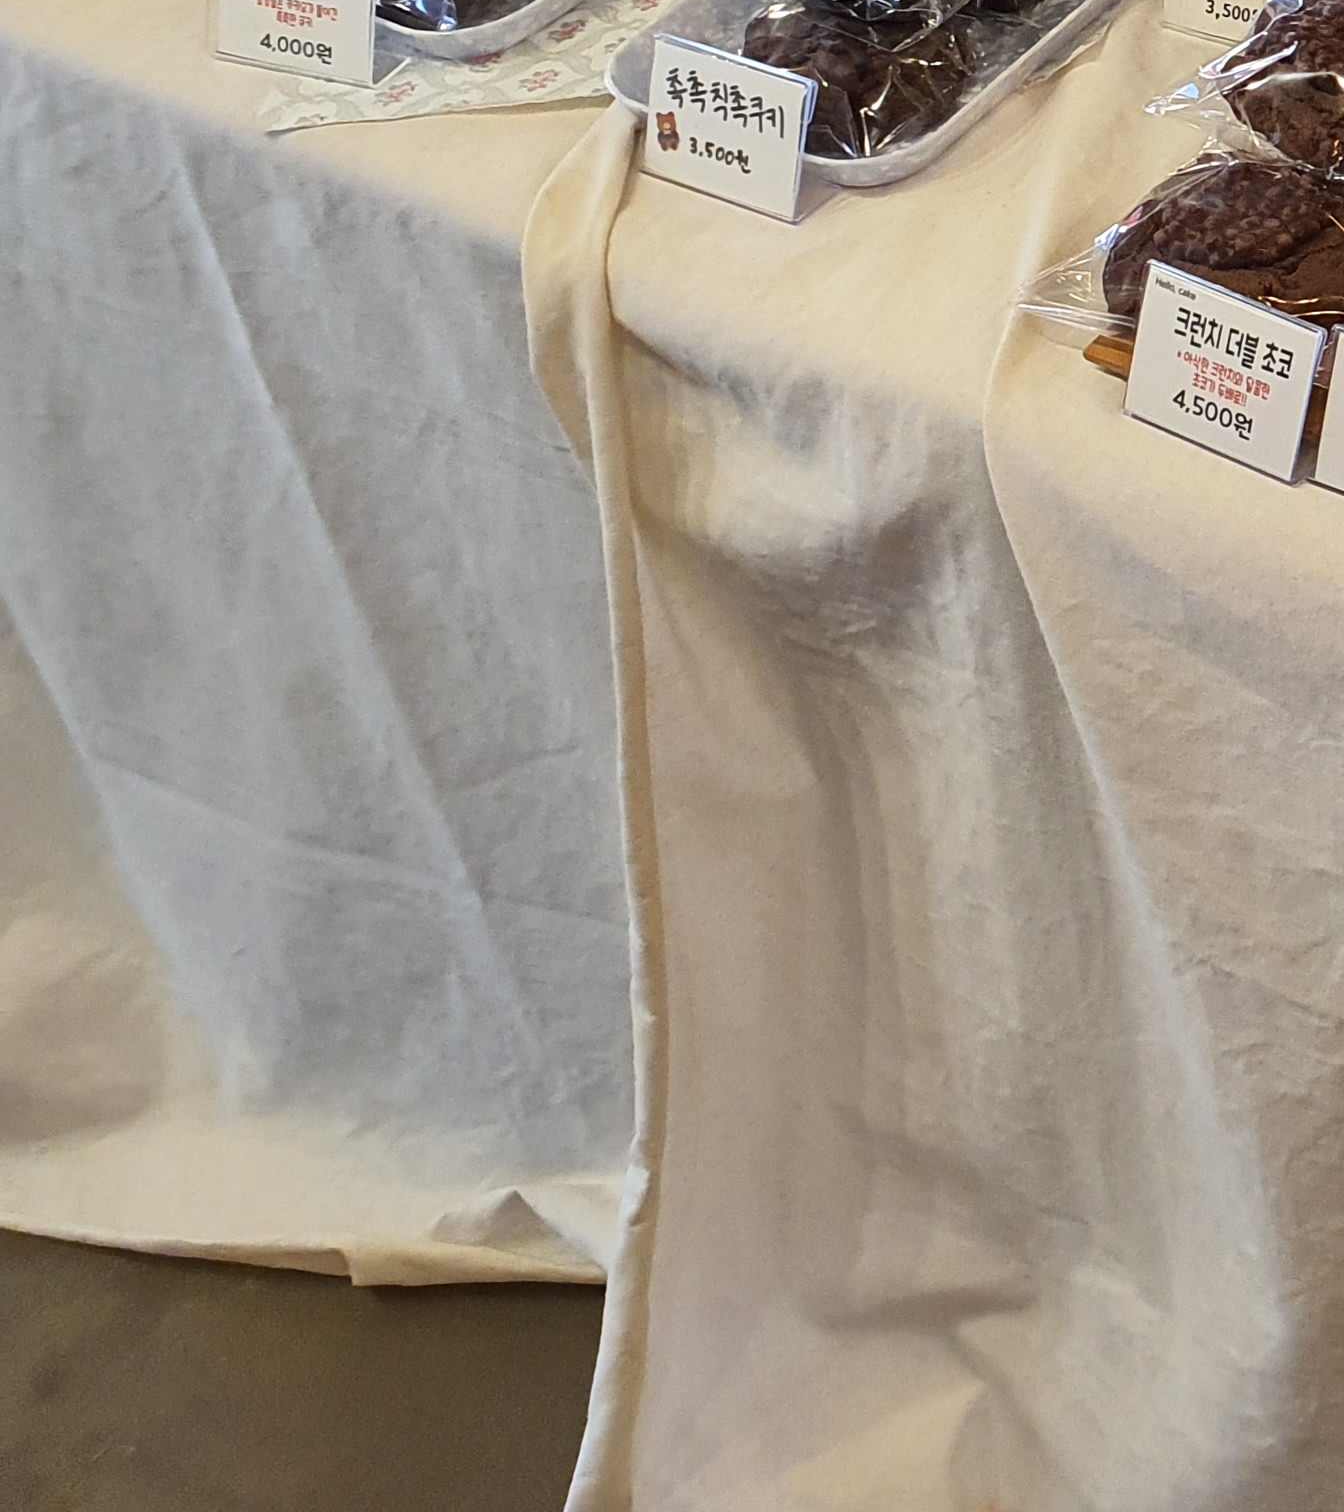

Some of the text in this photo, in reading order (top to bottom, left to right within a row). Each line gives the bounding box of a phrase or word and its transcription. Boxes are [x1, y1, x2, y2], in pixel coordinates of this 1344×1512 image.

[1205, 0, 1257, 22] 3,500
[260, 33, 333, 65] 4,000원
[1174, 307, 1294, 379] 크런치 더블 초코
[1172, 389, 1253, 441] 4,500원
